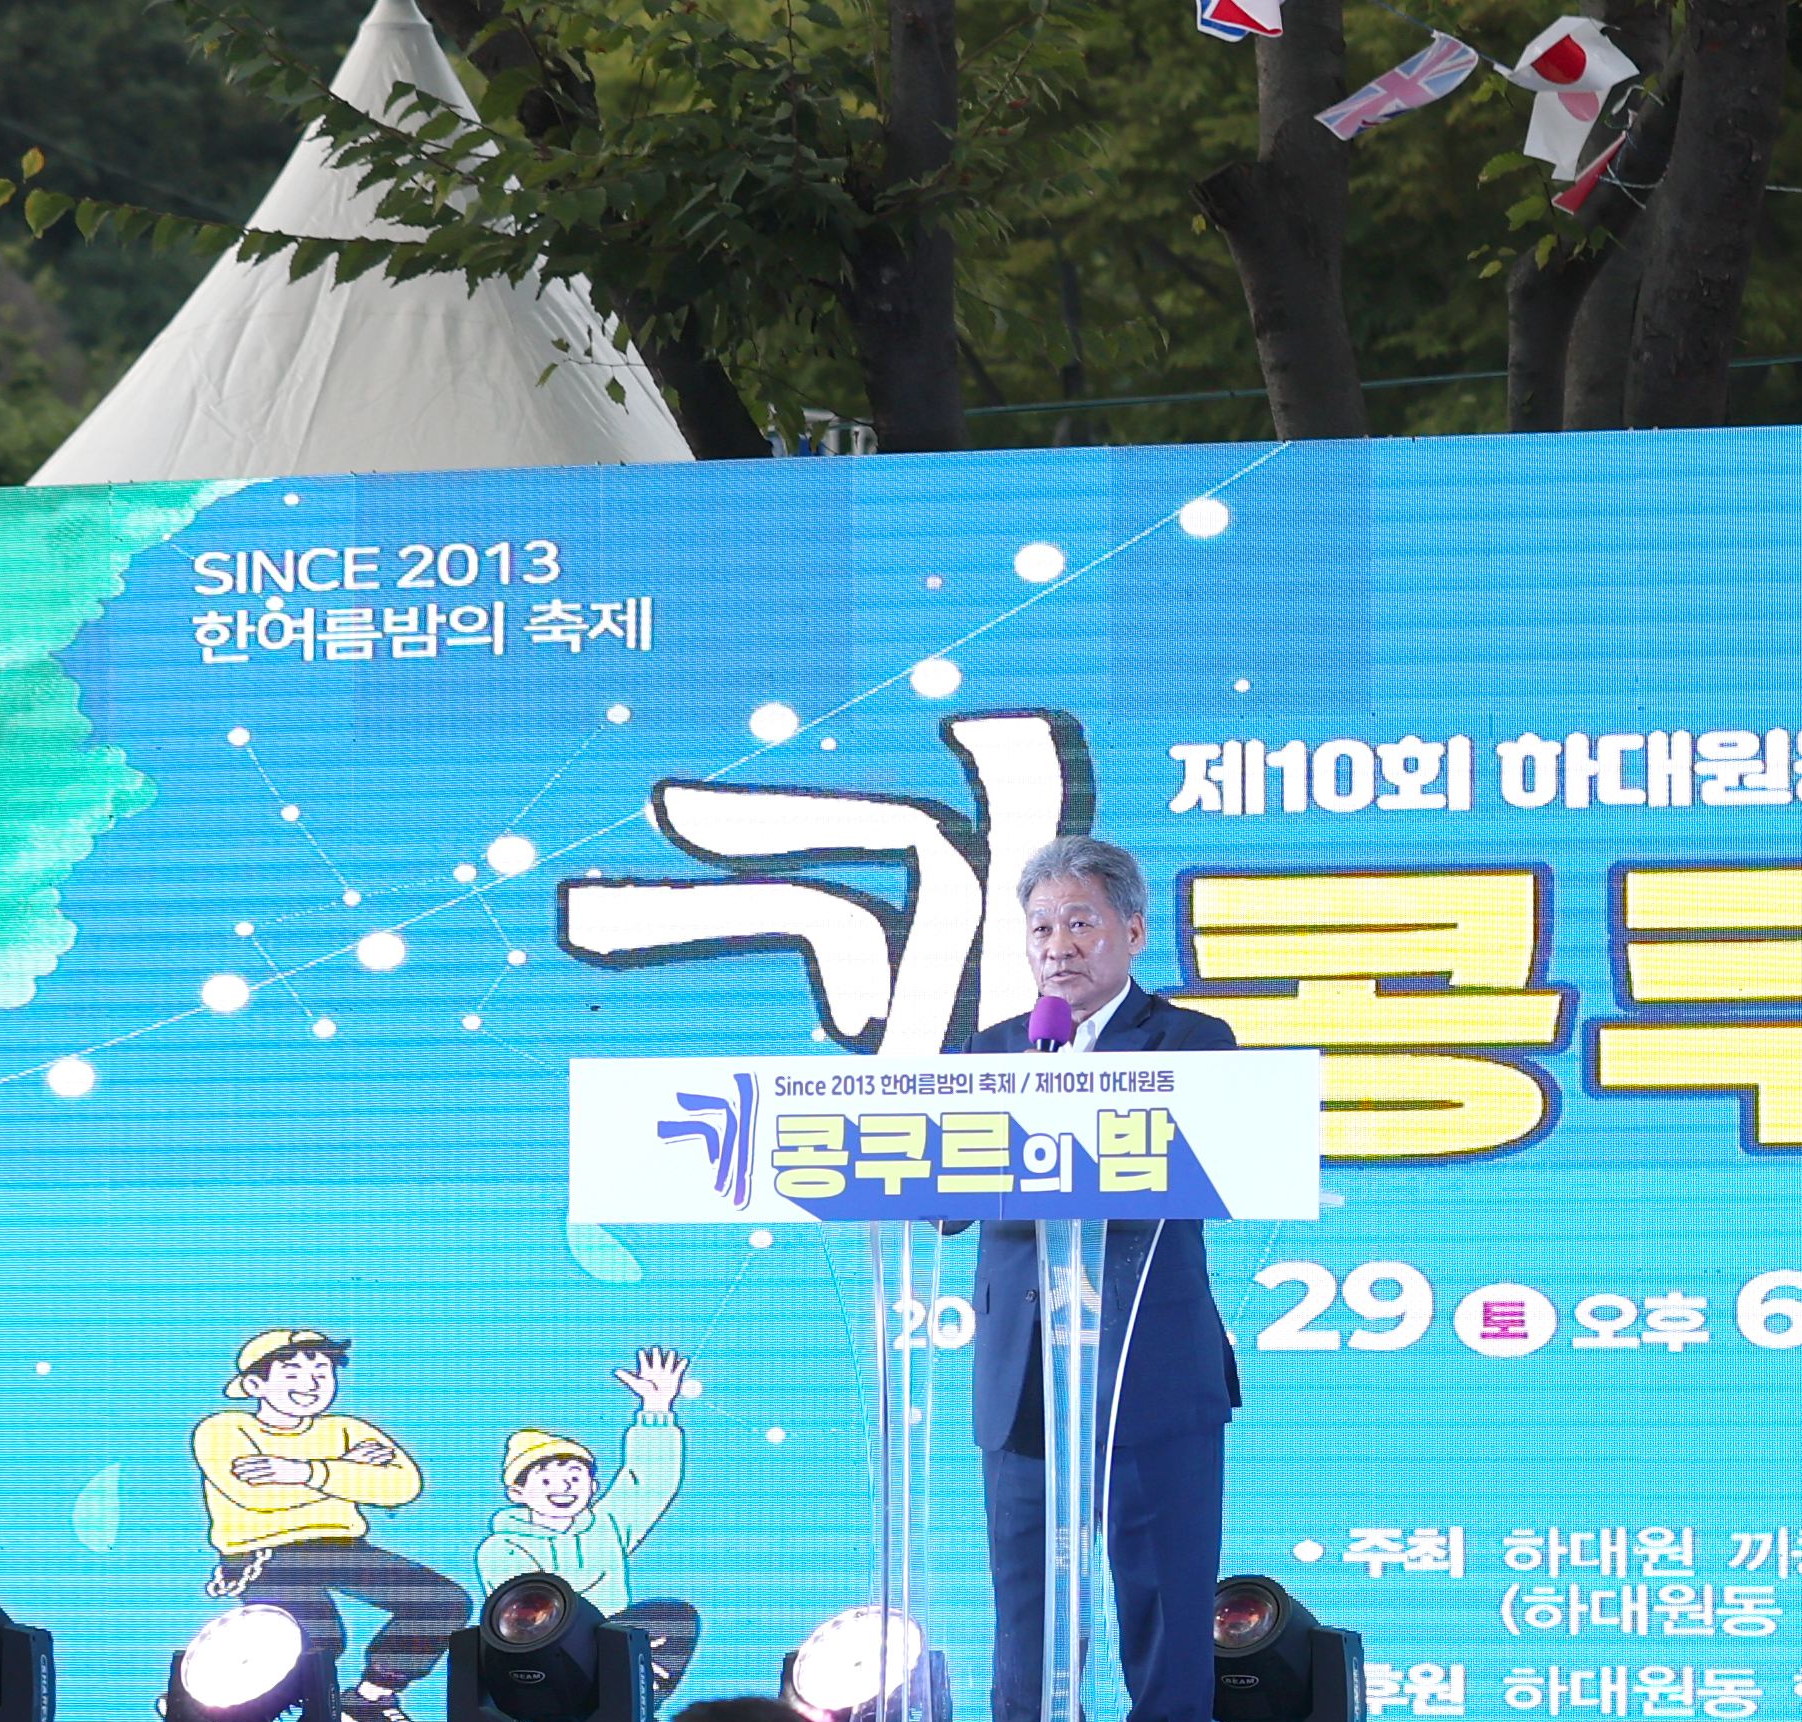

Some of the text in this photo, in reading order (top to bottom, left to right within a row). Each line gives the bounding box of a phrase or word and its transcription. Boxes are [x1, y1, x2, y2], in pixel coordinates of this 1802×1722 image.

[193, 540, 561, 595] SINCE 2013
[192, 596, 654, 664] 한여름밤의 축제
[1168, 734, 1473, 817] 제10회
[774, 1075, 827, 1096] Since
[832, 1074, 876, 1096] 2013
[881, 1073, 974, 1096] 한여름밤의
[979, 1072, 1016, 1095] 축제
[1035, 1071, 1094, 1094] 제10회
[1099, 1070, 1175, 1094] 하대원동
[771, 1111, 1074, 1199] 콩쿠르의
[1097, 1107, 1176, 1193] 밤
[1573, 1292, 1710, 1352] 오후
[1343, 1526, 1465, 1579] 주최
[1502, 1526, 1694, 1579] 하대원
[1501, 1582, 1783, 1638] (하대원동
[1503, 1665, 1763, 1720] 하대원동
